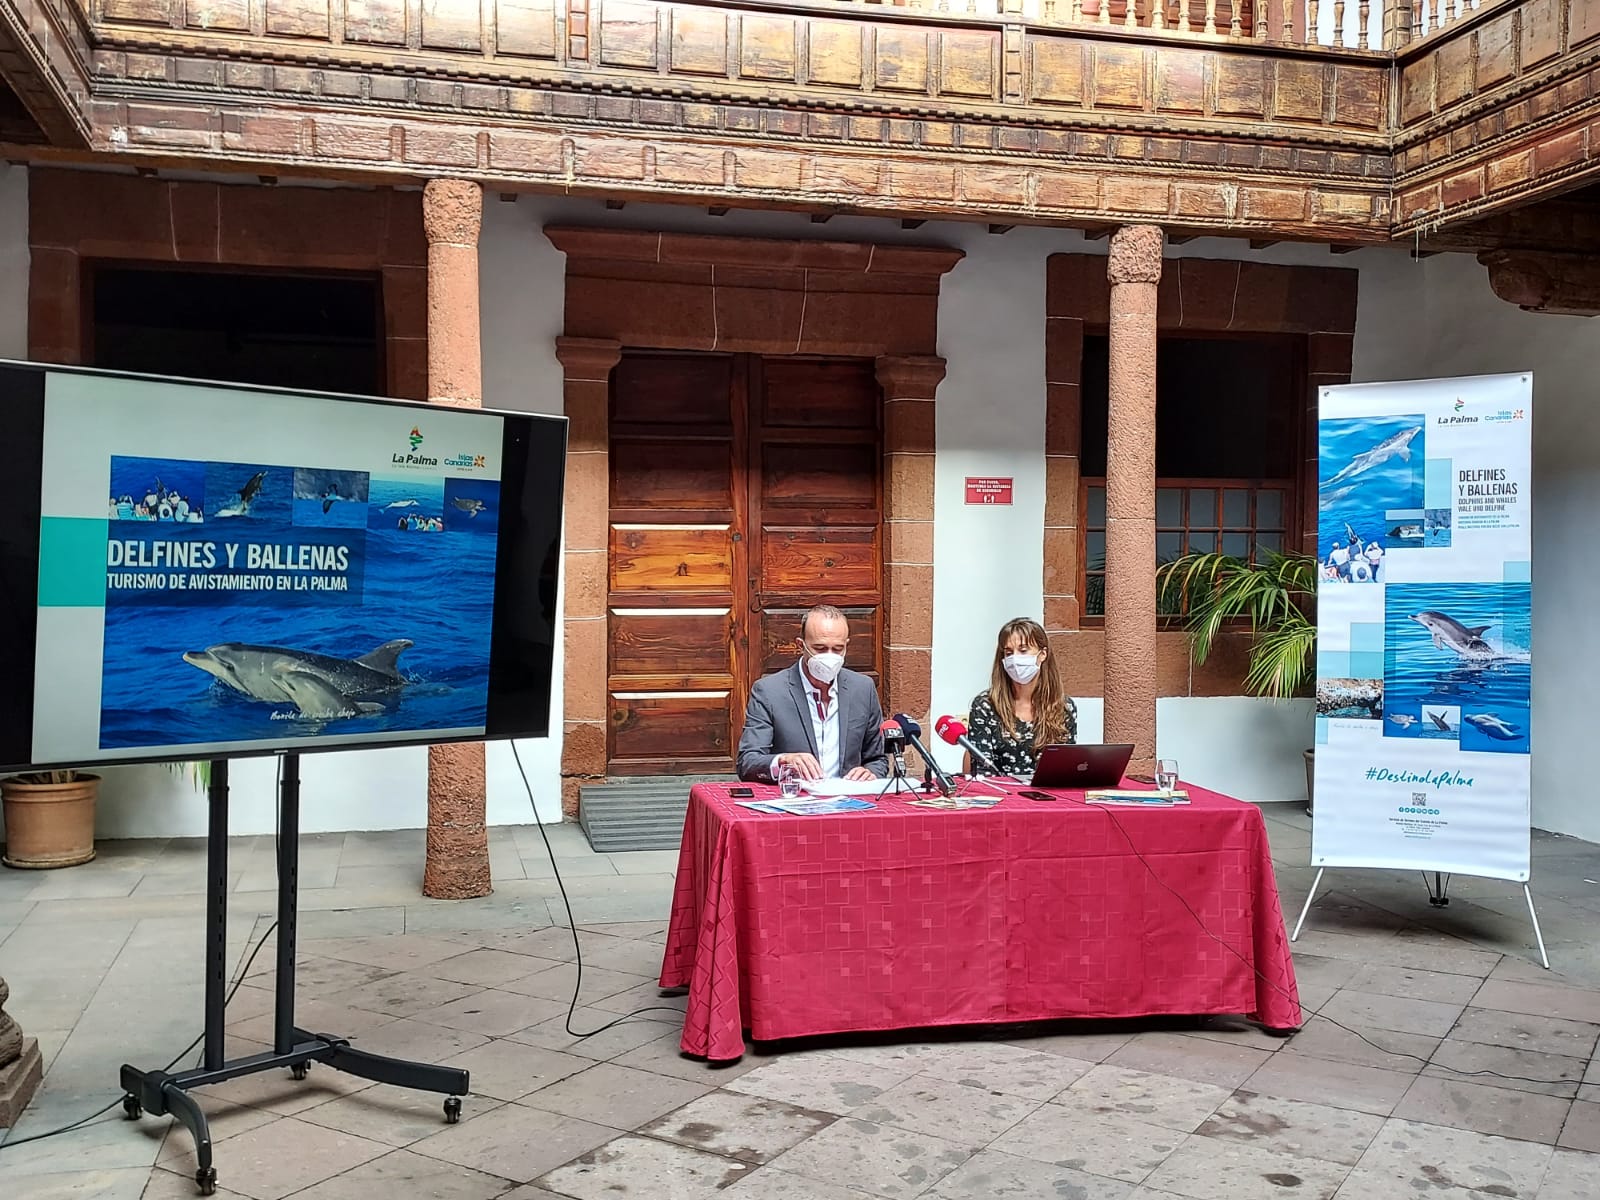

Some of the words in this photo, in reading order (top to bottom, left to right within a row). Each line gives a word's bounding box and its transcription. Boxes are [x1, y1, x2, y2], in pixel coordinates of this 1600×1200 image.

[1438, 416, 1448, 424] La
[1450, 415, 1478, 424] Palma
[392, 453, 404, 463] La
[406, 454, 438, 466] Palma
[444, 458, 473, 467] Canarias
[458, 453, 473, 461] Islas
[1459, 468, 1506, 482] DELFINES
[1458, 484, 1465, 496] Y
[1467, 482, 1518, 496] BALLENAS
[1496, 496, 1517, 504] WHALES
[107, 540, 216, 569] DELFINES
[225, 543, 239, 569] Y
[247, 543, 349, 571] BALLENAS
[107, 573, 166, 590] TURISMO
[169, 574, 186, 590] DE
[188, 574, 274, 591] AVISTAMIENTO
[276, 575, 291, 591] EN
[294, 576, 308, 591] LA
[310, 576, 348, 591] PALMA
[1365, 766, 1474, 789] #DestinoLaPalma
